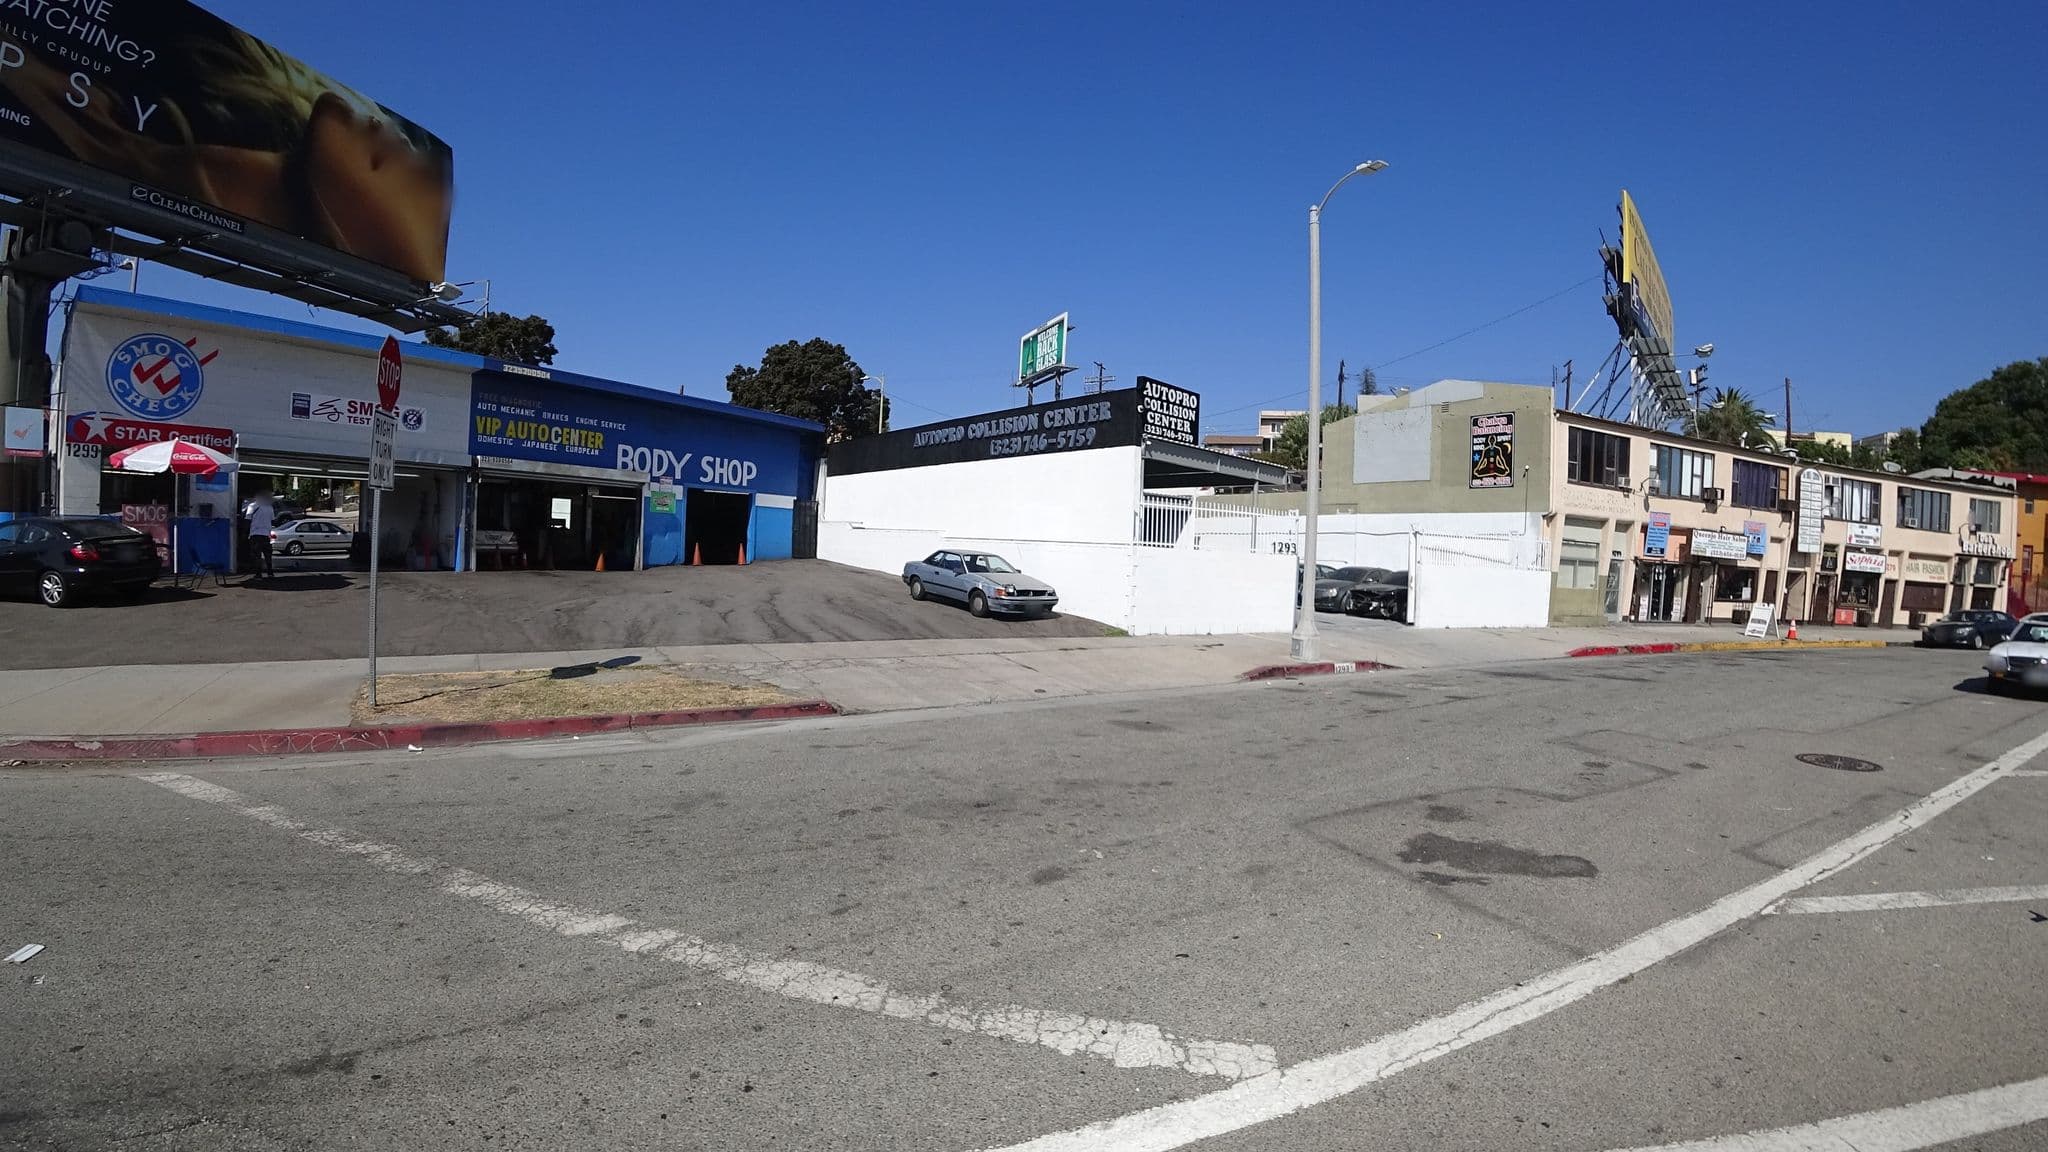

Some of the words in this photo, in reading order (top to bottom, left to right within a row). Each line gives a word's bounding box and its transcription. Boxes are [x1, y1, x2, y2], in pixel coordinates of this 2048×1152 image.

[56, 0, 113, 22] NE
[0, 0, 155, 68] ATCHING?
[0, 21, 39, 44] ILLY
[47, 41, 112, 74] CRUDUP
[117, 340, 194, 369] SMOG
[1037, 333, 1059, 356] BACK
[1036, 350, 1058, 372] GLASS
[379, 356, 400, 390] STOP
[113, 377, 200, 412] CHECK
[1143, 381, 1198, 409] AUTOPRO
[347, 415, 372, 426] TEST
[477, 402, 497, 411] AUTO
[501, 405, 536, 417] MECHANIC
[543, 411, 569, 422] BRAKES
[575, 416, 598, 426] ENGINE
[601, 420, 627, 431] SERVICE
[1144, 397, 1196, 422] COLLISION
[375, 417, 395, 440] RIGHT
[476, 416, 502, 436] VIP
[913, 426, 965, 448] AUTOPRO
[967, 412, 1040, 440] COLLISION
[1044, 401, 1112, 429] CENTER
[1147, 411, 1191, 433] CENTER
[115, 426, 160, 441] STAR
[168, 430, 231, 448] Certified
[477, 434, 514, 446] DOMESTIC
[522, 440, 558, 452] JAPANESE
[565, 445, 600, 456] EUROPEAN
[1023, 427, 1097, 453] 746-5759
[66, 443, 99, 459] 1299
[375, 440, 393, 460] TURN
[373, 463, 392, 482] ONLY
[617, 443, 693, 480] BODY
[700, 455, 758, 487] SHOP
[123, 504, 168, 522] SMOG
[1271, 541, 1297, 554] 1293
